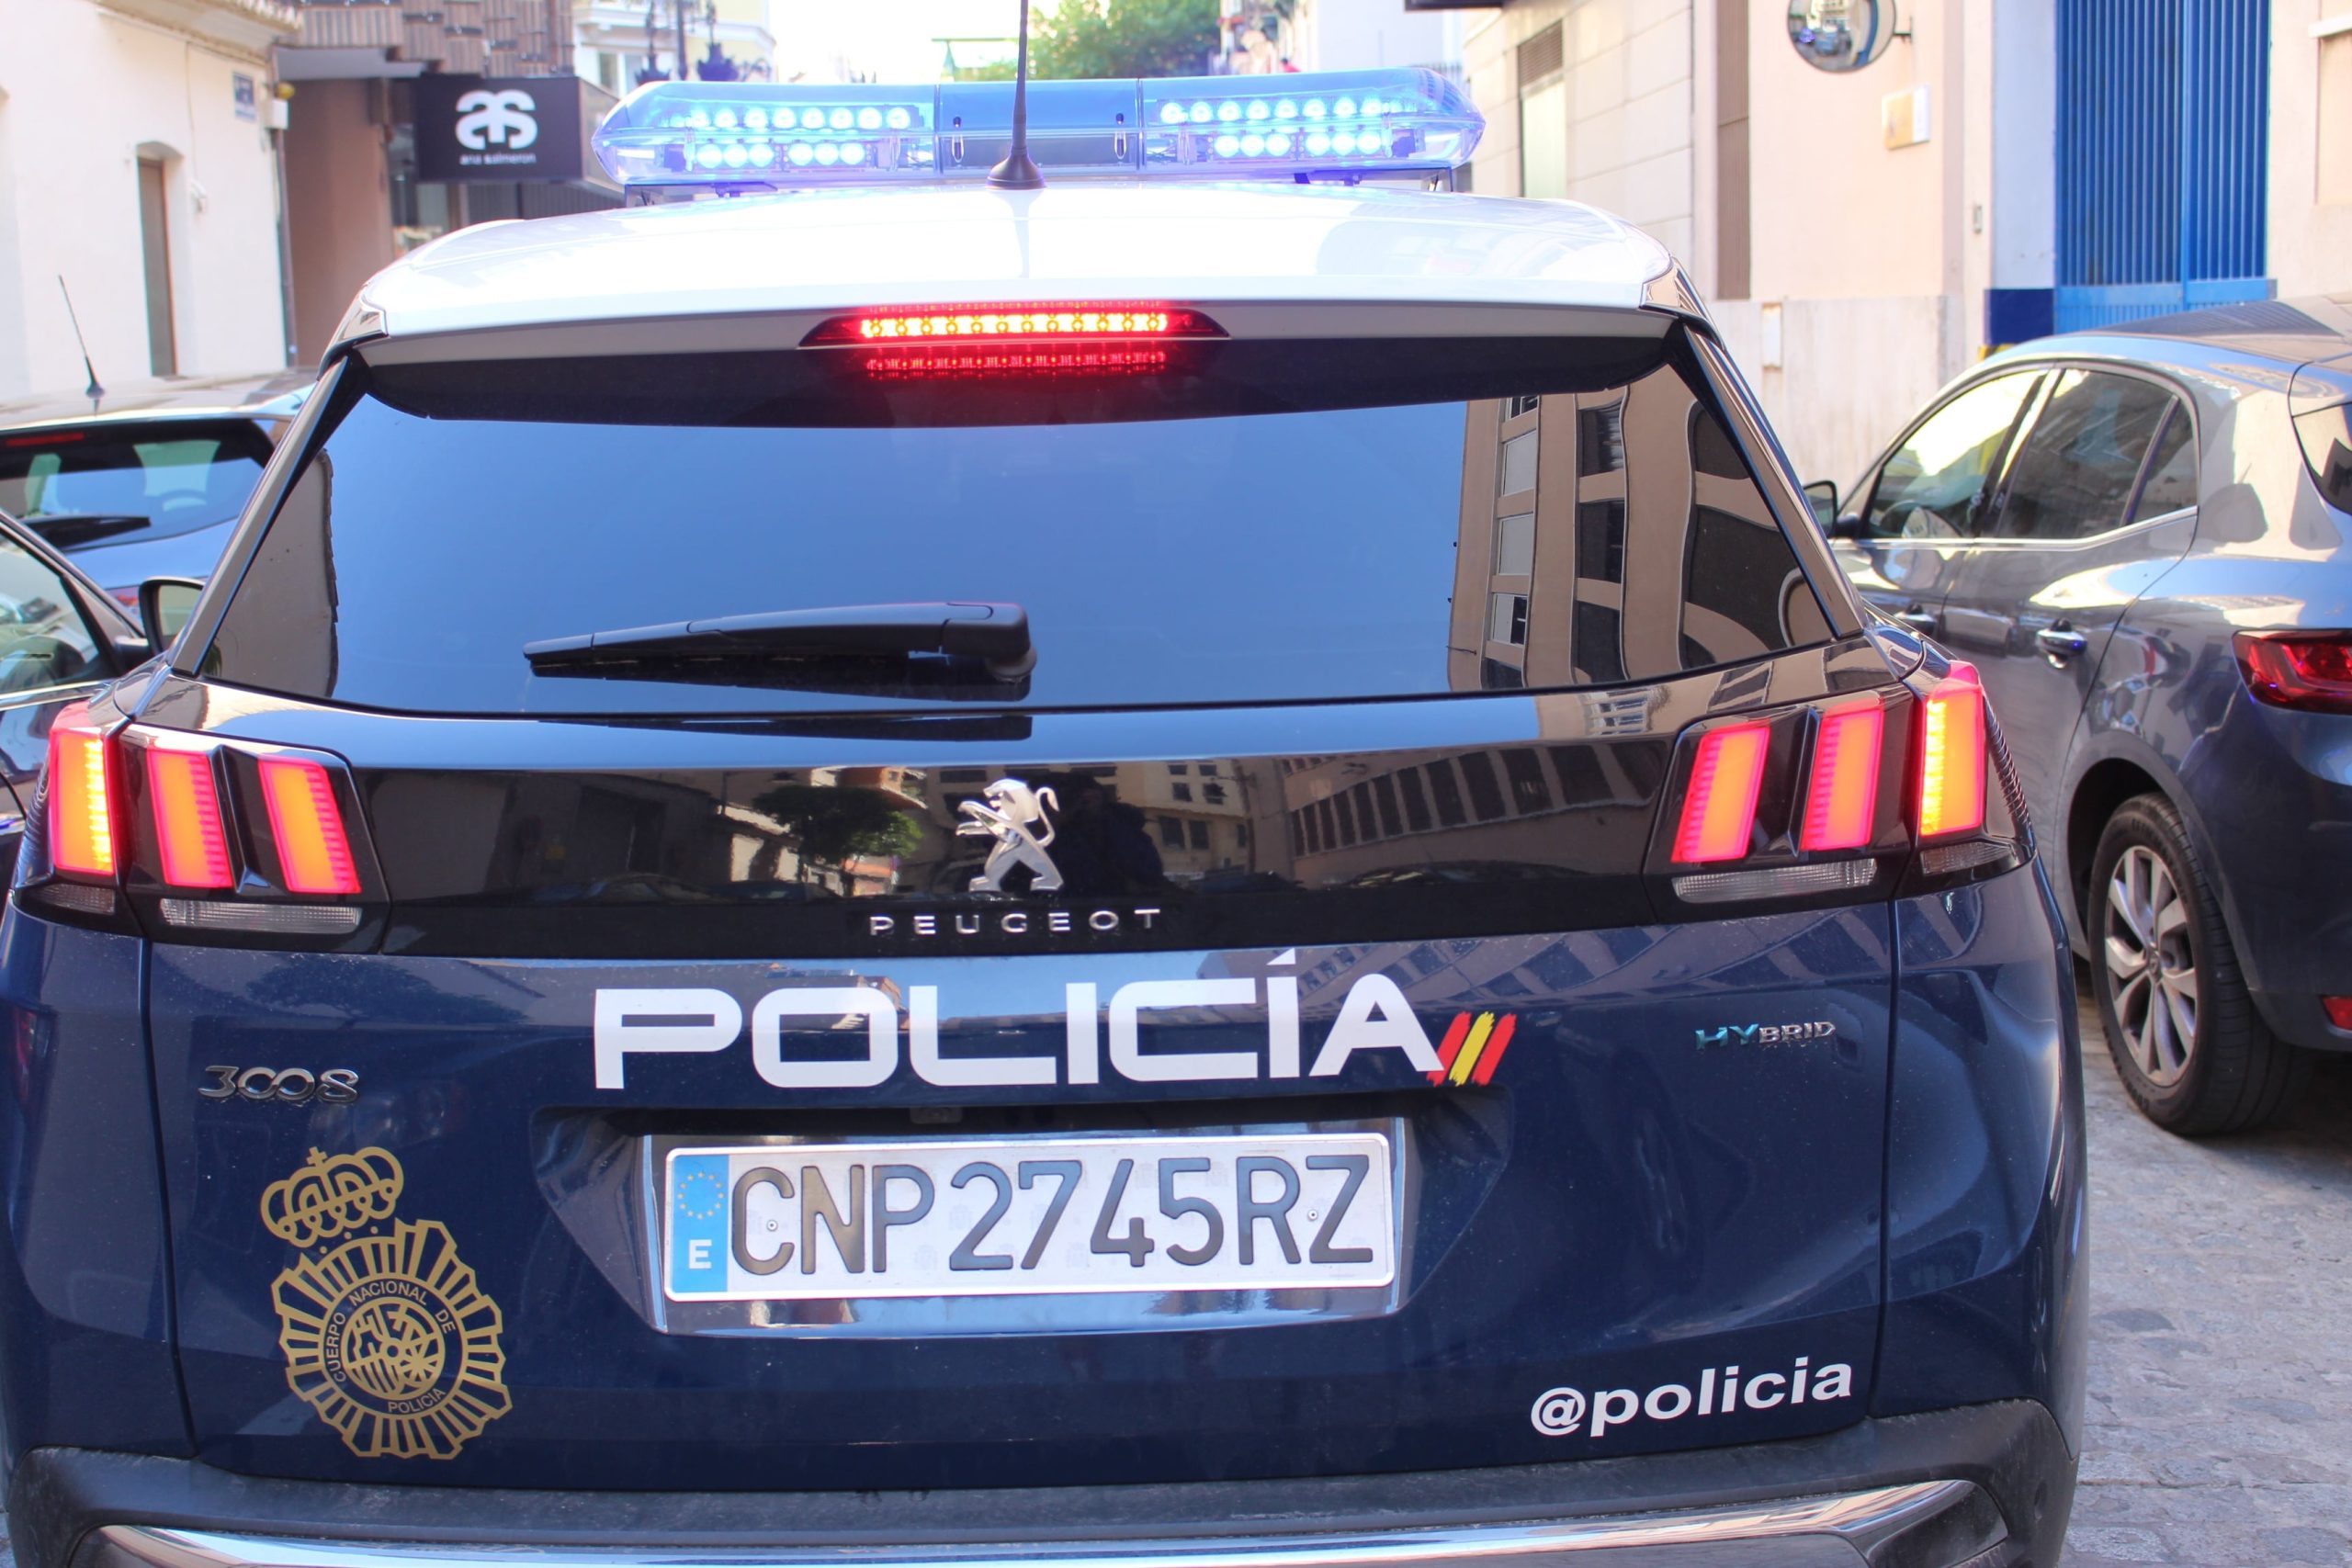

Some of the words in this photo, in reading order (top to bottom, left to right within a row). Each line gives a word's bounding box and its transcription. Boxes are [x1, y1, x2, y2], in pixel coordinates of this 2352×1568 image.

[869, 908, 1161, 936] PEUGEOT
[594, 947, 1444, 1089] POLICÍA
[1695, 1021, 1837, 1050] HYBRID
[198, 1065, 360, 1103] 3008
[689, 1239, 712, 1269] E
[326, 1312, 347, 1383] CUERPO
[348, 1280, 427, 1306] NACIONAL
[435, 1309, 457, 1334] DE
[388, 1387, 447, 1414] POLICIA
[1531, 1356, 1852, 1437] @policia
